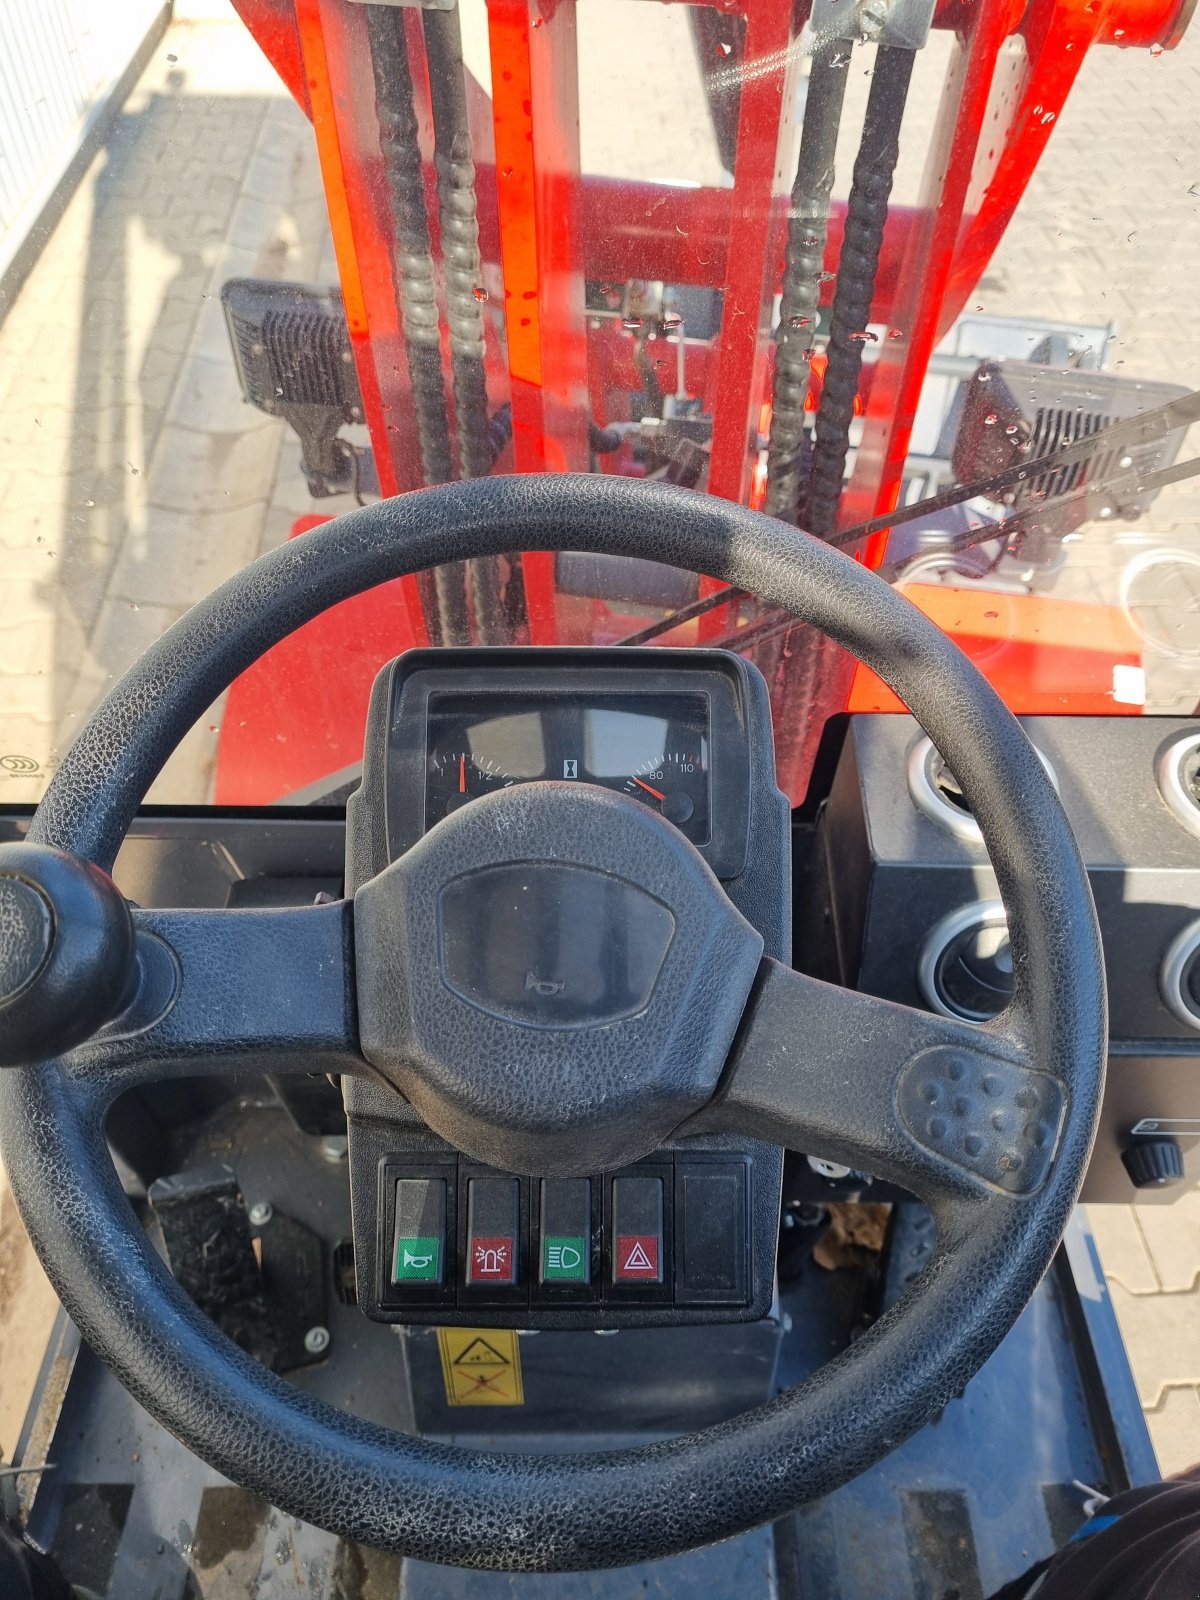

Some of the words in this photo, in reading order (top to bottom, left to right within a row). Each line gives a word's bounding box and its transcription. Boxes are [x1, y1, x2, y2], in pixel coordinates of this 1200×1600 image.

[680, 763, 695, 773] 110
[478, 771, 493, 780] 1/2
[649, 771, 664, 780] 80
